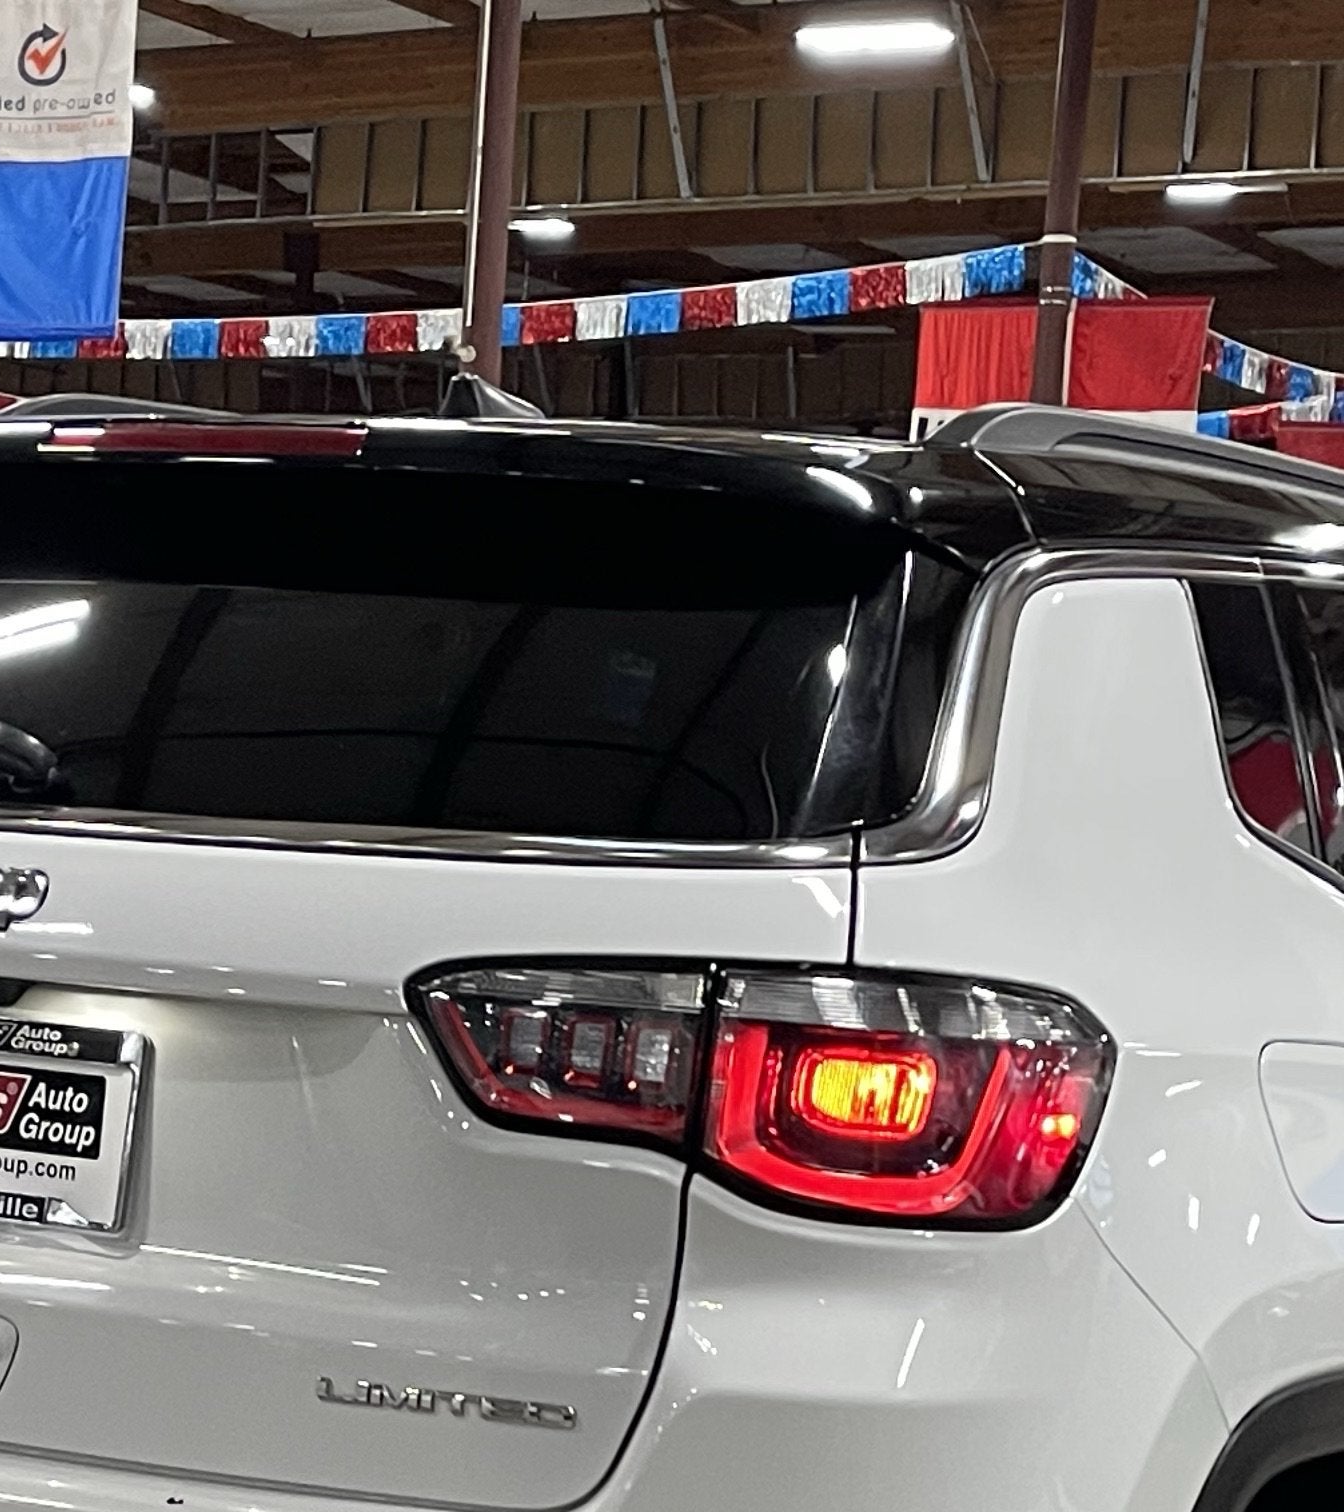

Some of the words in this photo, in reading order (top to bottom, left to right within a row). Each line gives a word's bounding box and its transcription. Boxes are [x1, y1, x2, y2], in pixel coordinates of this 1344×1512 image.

[33, 88, 116, 114] pre-owed
[10, 1036, 68, 1056] Group
[16, 1025, 62, 1041] Auto
[28, 1081, 90, 1113] Auto
[19, 1112, 96, 1152] Group
[315, 1375, 578, 1431] LIMITED
